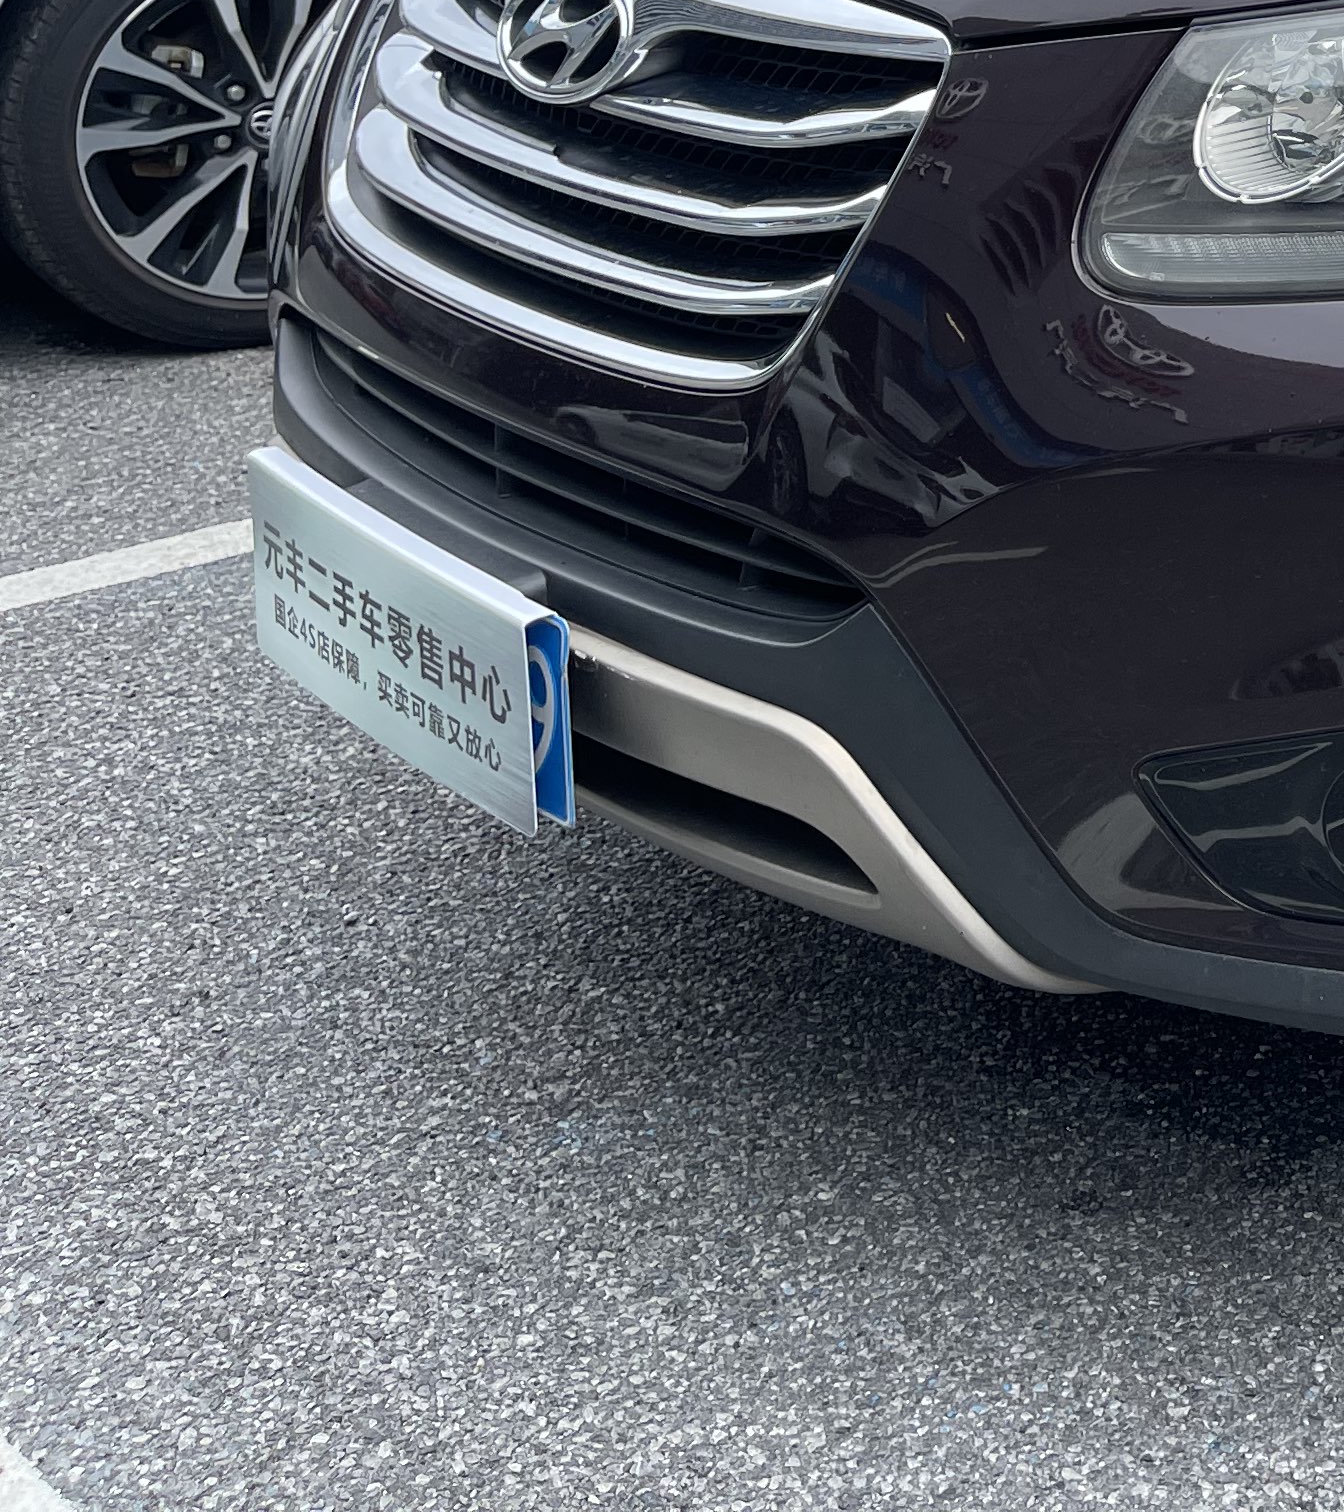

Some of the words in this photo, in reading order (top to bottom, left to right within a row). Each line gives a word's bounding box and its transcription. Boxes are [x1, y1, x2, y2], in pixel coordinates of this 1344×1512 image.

[263, 520, 512, 725] 元丰二手车零售中心
